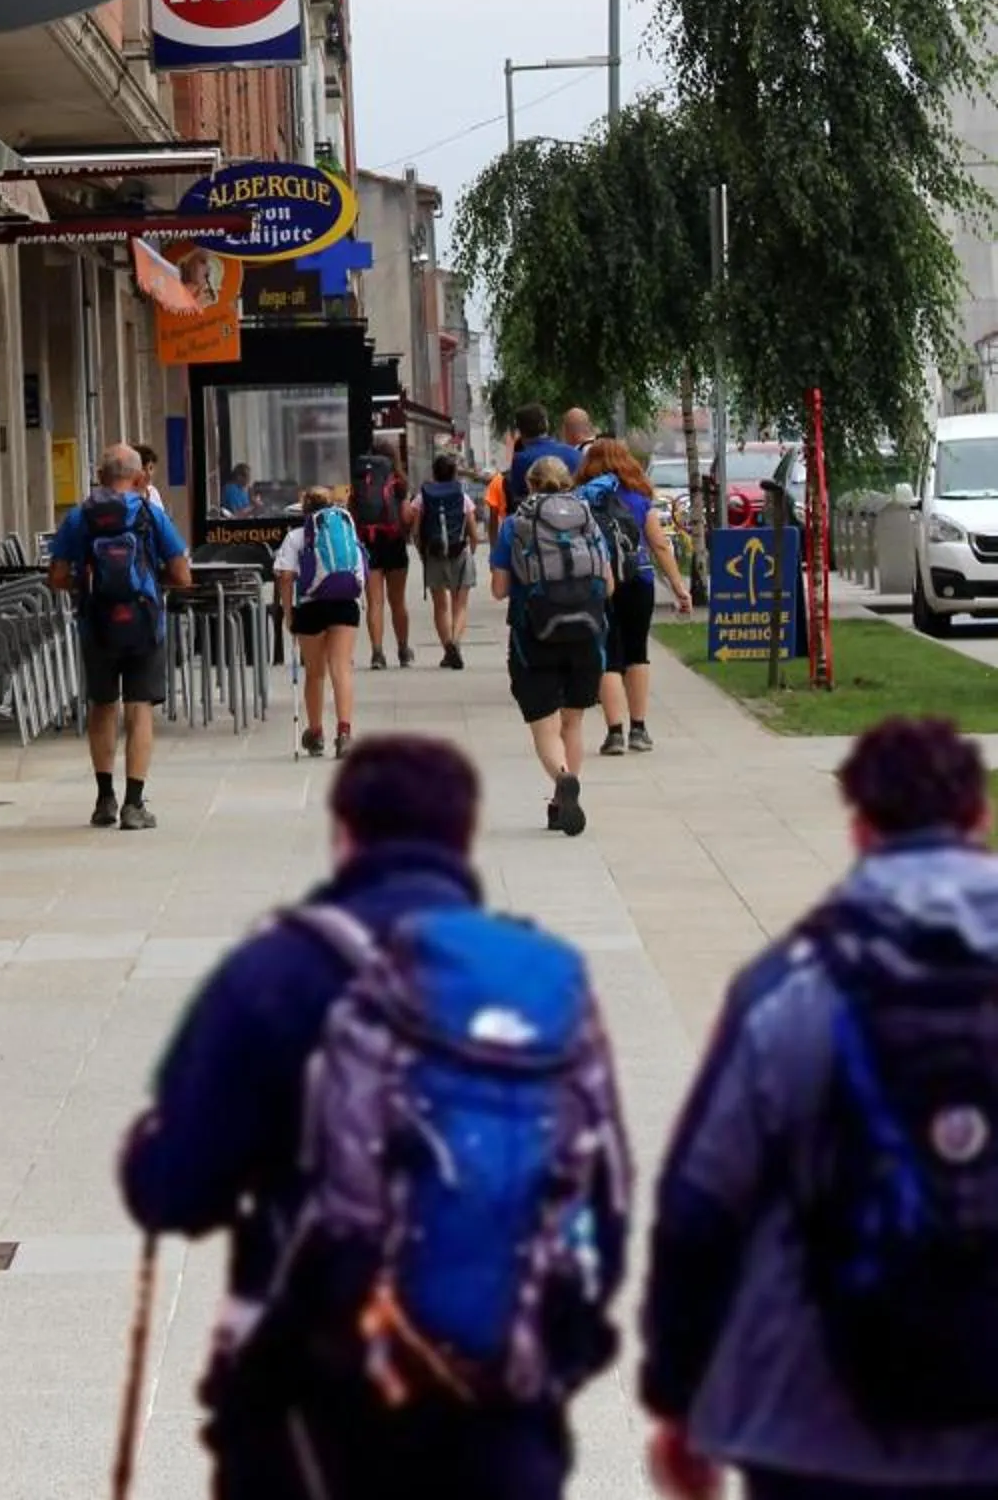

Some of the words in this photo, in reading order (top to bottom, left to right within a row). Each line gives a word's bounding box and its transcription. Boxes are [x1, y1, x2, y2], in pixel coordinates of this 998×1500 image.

[208, 175, 331, 207] ALBERGUE
[226, 225, 313, 247] uijote
[715, 611, 791, 625] ALBERGE
